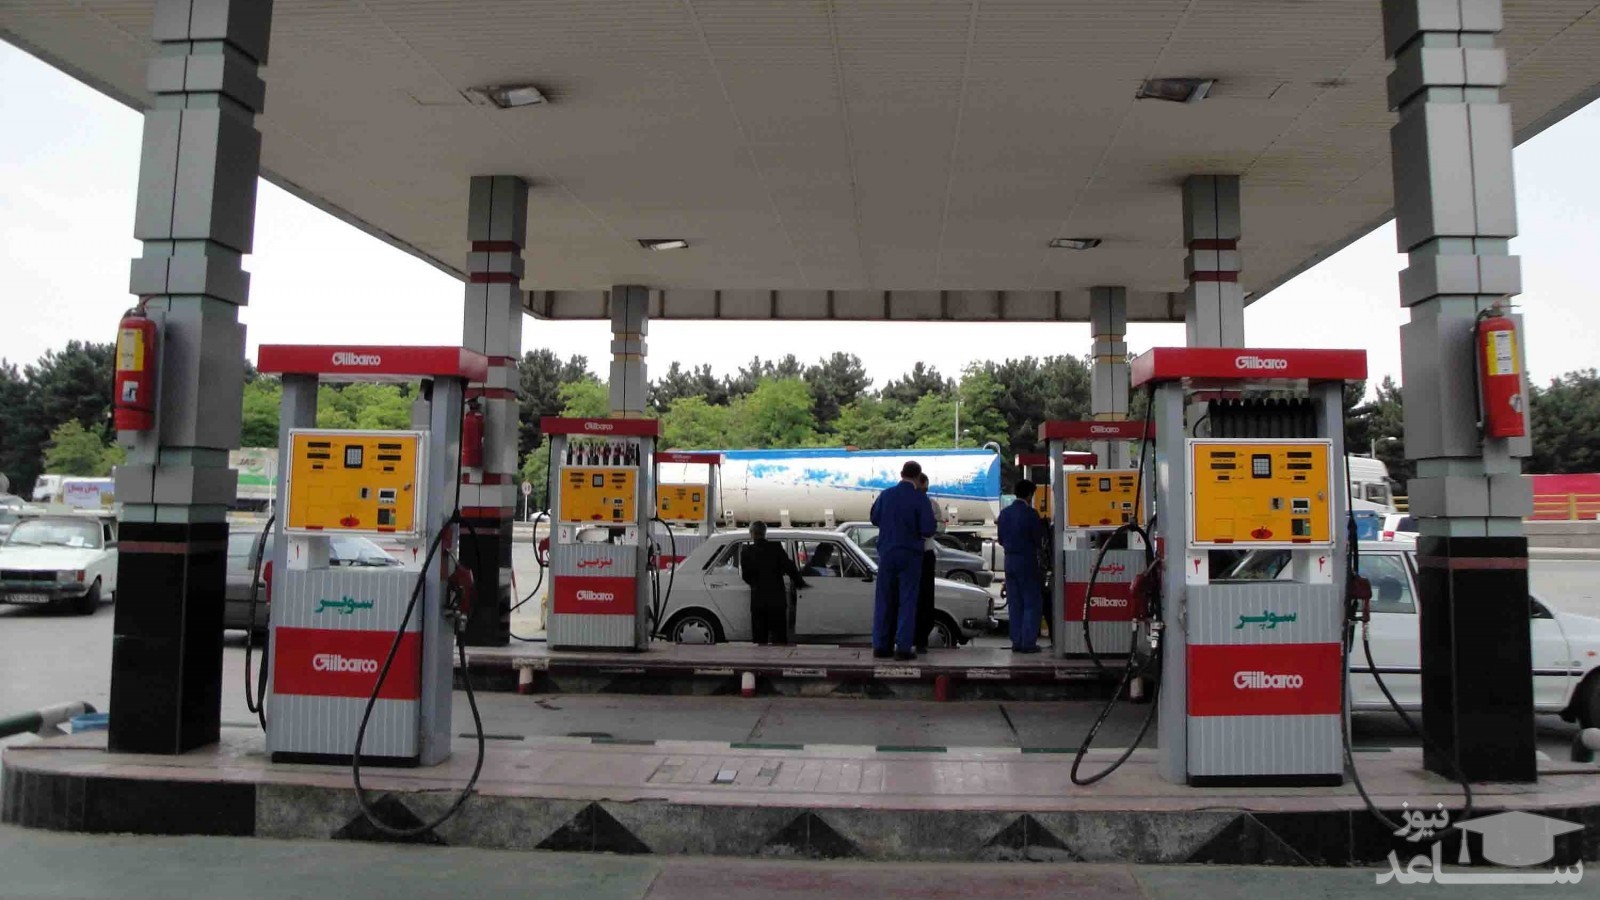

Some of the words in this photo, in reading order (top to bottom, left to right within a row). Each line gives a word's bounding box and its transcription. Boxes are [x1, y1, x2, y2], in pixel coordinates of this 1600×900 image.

[332, 351, 381, 366] Gilbarco
[1235, 356, 1288, 370] Gilbarco
[584, 422, 614, 431] Gilbarco
[577, 556, 613, 569] بنزین
[576, 590, 614, 601] Gilbarco
[1090, 596, 1128, 608] Gilbarco
[314, 594, 375, 615] سوپر
[1234, 609, 1297, 630] سوپر
[312, 653, 379, 673] Gilbarco
[1233, 671, 1304, 690] Gilbarco
